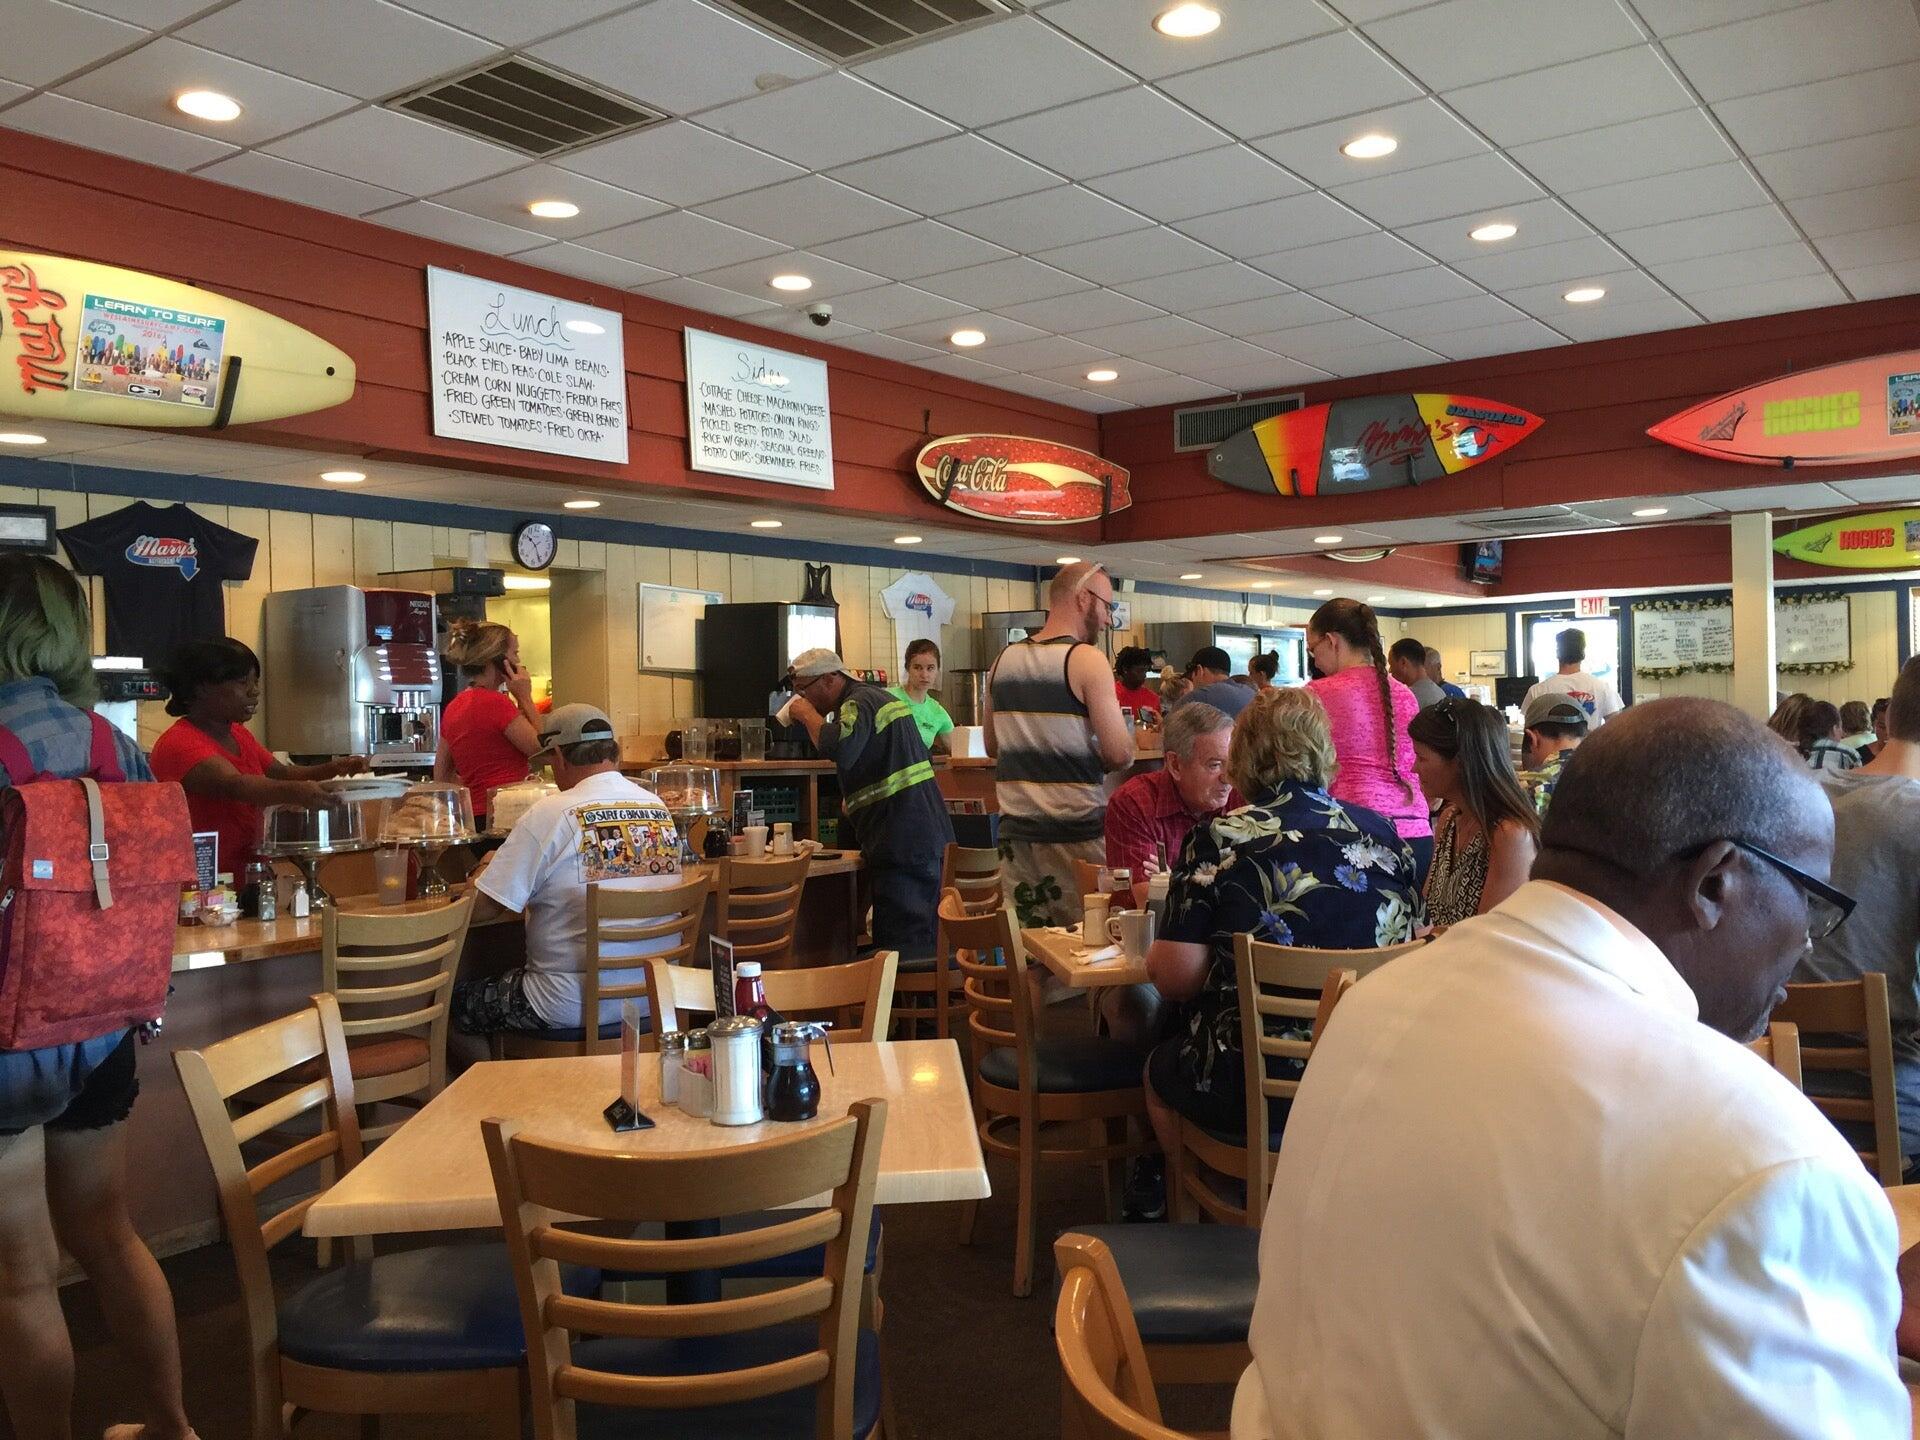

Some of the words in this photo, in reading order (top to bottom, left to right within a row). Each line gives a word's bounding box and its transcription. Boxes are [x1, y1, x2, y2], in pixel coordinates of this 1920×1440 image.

[94, 298, 147, 316] LEARN
[151, 310, 173, 320] TO
[177, 313, 217, 328] SURF
[485, 293, 570, 342] Lunch
[445, 332, 475, 349] APPLE
[480, 338, 511, 356] SAUCE
[520, 346, 543, 362] BABY
[546, 351, 569, 367] LIMA
[575, 359, 607, 378] BEANS
[446, 351, 476, 368] BLACK
[482, 358, 509, 374] EYED
[512, 365, 535, 378] PEAS
[538, 369, 562, 383] COLE
[566, 374, 592, 390] SLAW
[443, 371, 480, 387] CREAM
[485, 377, 511, 392] CORN
[516, 384, 562, 403] NUGGETS
[566, 392, 597, 407] FRENCH
[601, 398, 622, 414] FRIES
[701, 383, 732, 400] COTTAGE
[737, 389, 762, 406] CHEESE
[446, 389, 477, 405] FRIED
[482, 395, 515, 411] GREEN
[518, 400, 563, 418] TOMATOES
[566, 408, 594, 424] GREEN
[596, 413, 621, 428] BEANS
[704, 402, 736, 417] MASHED
[740, 408, 770, 423] POTATOES
[774, 413, 795, 426] ONION
[798, 416, 819, 431] RINGS
[452, 410, 494, 426] STEWED
[498, 415, 542, 433] TOMATOES
[547, 422, 574, 439] FRIED
[578, 428, 601, 443] OKRA
[701, 417, 730, 431] PICKLED
[734, 422, 757, 435] BEETS
[762, 426, 784, 439] POTATO
[703, 432, 720, 443] RICE
[734, 438, 757, 448] GRAVY
[760, 440, 795, 455] SEASONAL
[704, 446, 727, 458] POTATO
[730, 451, 751, 464] CHIPS
[800, 460, 820, 475] FRIES
[935, 455, 1008, 492] Coa-Cola
[1581, 597, 1604, 615] EXIT
[595, 809, 618, 821] SURF
[627, 809, 650, 819] BIKINI
